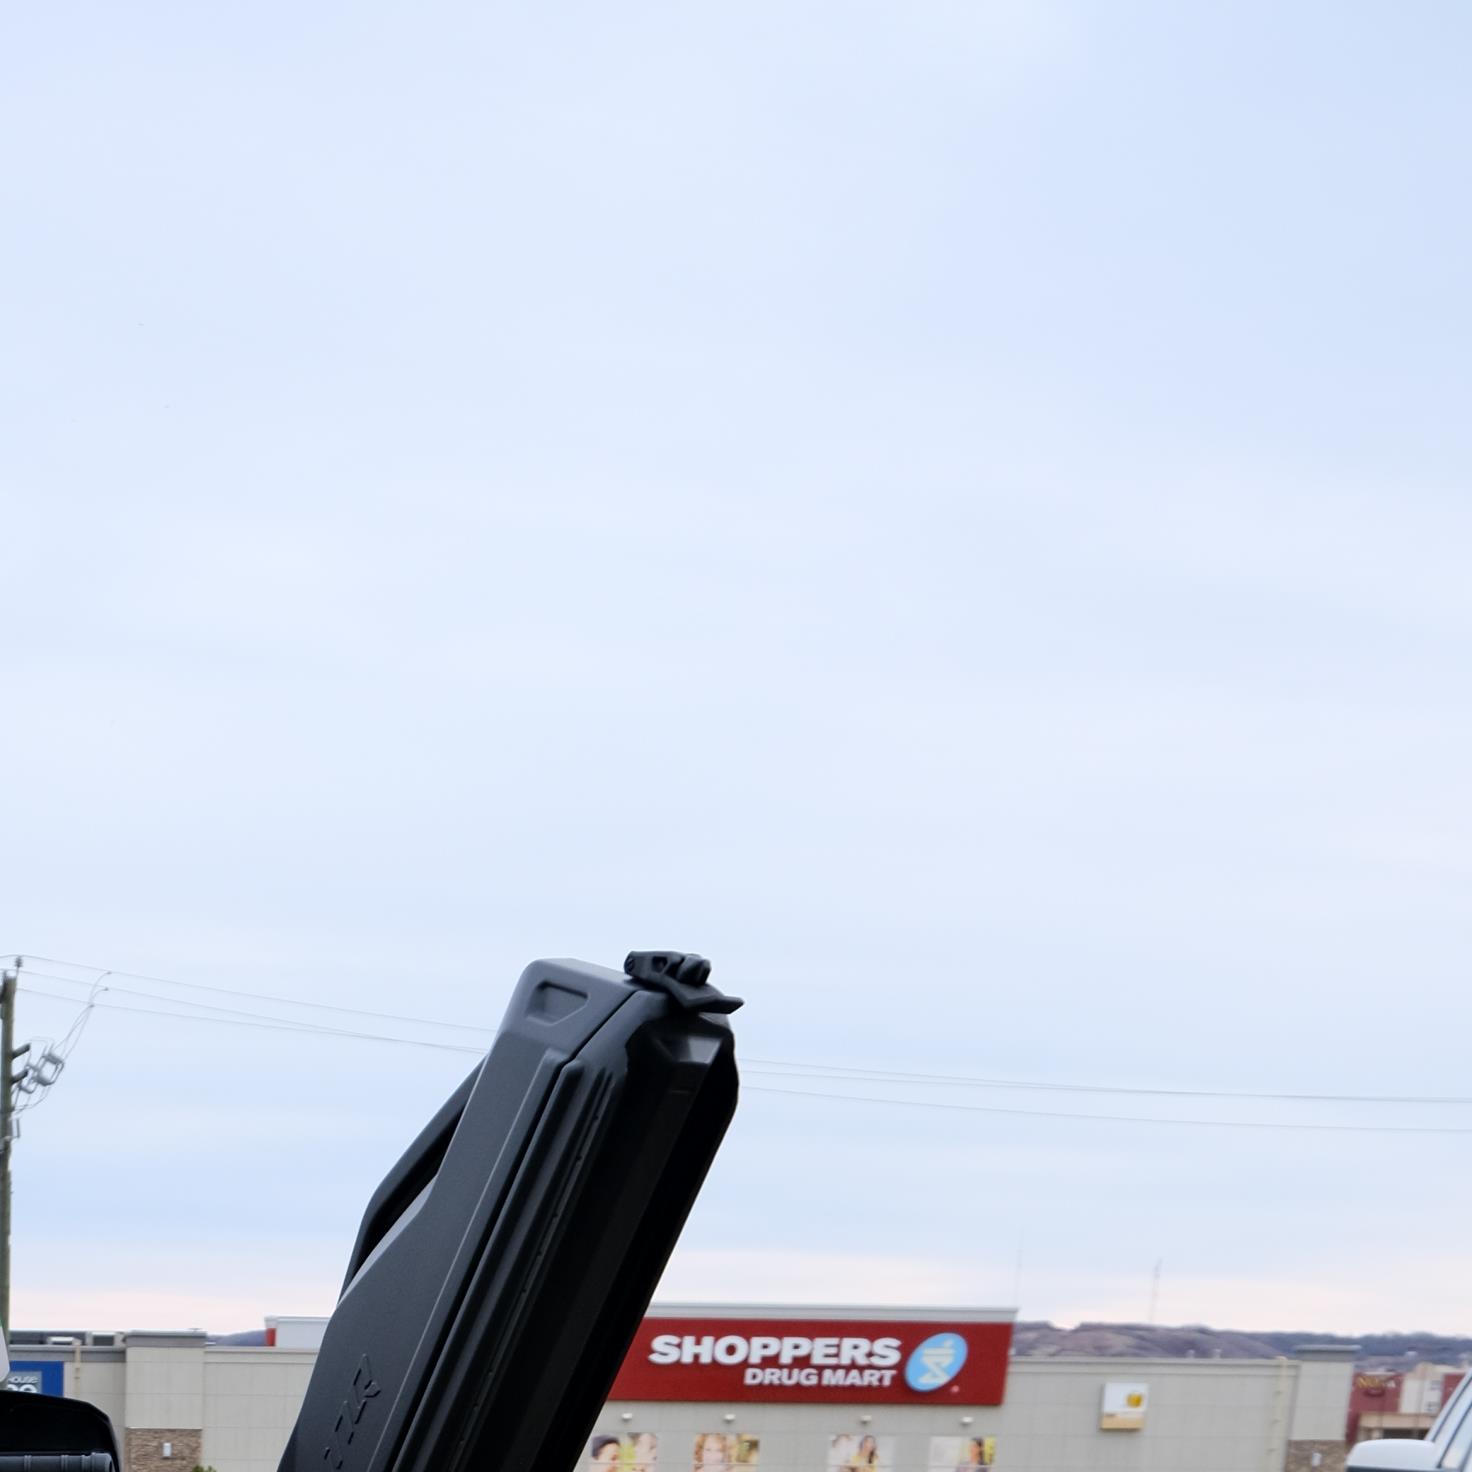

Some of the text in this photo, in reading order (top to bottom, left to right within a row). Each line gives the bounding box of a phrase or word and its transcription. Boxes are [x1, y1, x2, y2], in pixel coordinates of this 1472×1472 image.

[648, 1334, 902, 1366] SHOPPERS
[744, 1367, 897, 1387] DRUG MART
